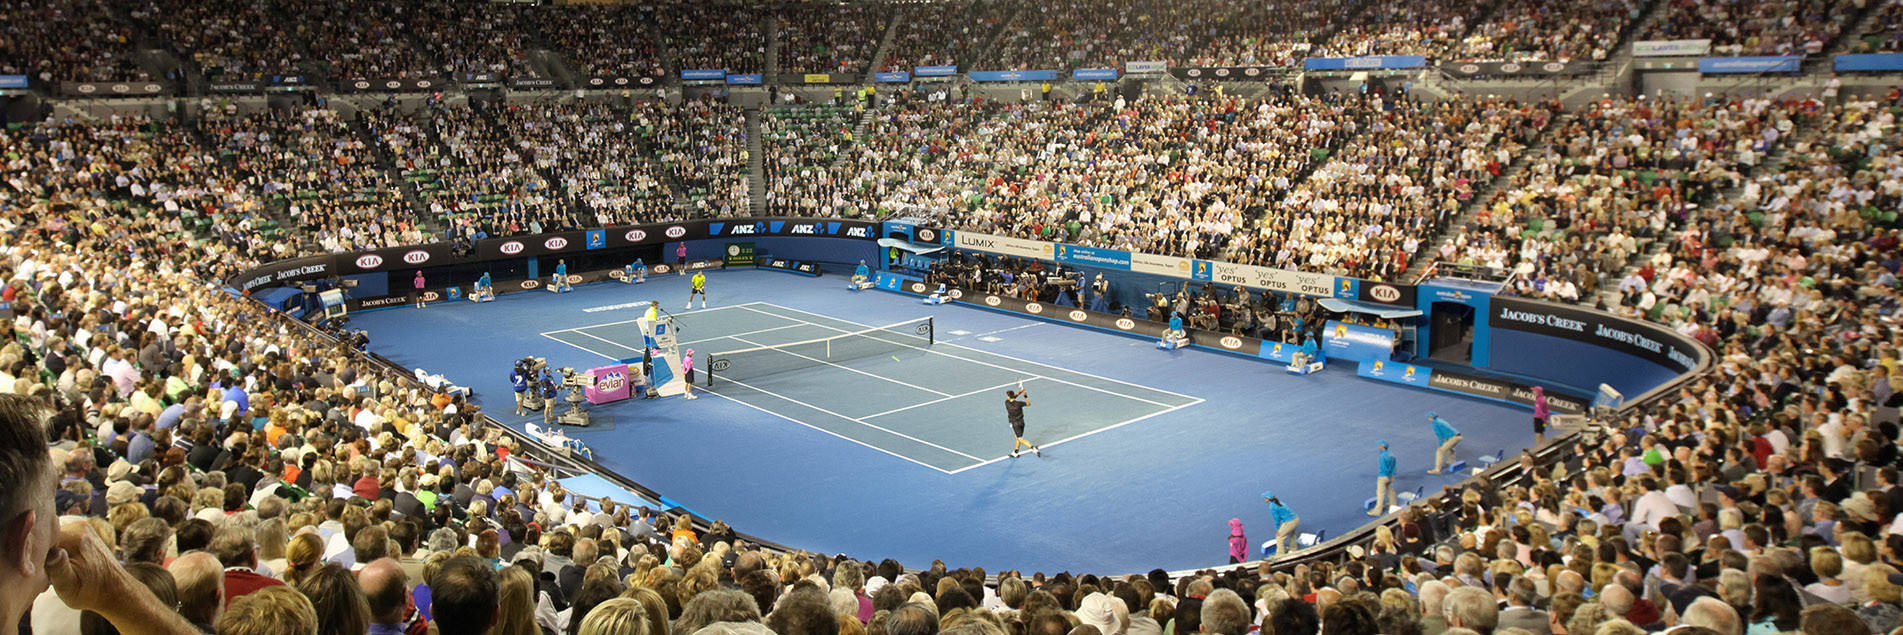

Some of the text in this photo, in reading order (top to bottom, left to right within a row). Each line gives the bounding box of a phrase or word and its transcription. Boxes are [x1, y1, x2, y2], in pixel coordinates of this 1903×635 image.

[731, 224, 755, 234] ANZ
[791, 224, 814, 234] ANZ
[846, 226, 866, 238] ANZ
[961, 234, 995, 248] LUMIX
[277, 264, 327, 280] JACOB'S CREEK
[1221, 274, 1246, 284] OPTUS
[1260, 279, 1287, 289] OPTUS
[1301, 284, 1329, 295] OPTUS
[1375, 287, 1396, 299] KIA
[361, 296, 407, 307] JACOB'S CREEK
[1500, 307, 1585, 332] JACOB'S CREEK
[1595, 323, 1663, 353] JACOB'S CREEK
[599, 378, 625, 391] evian
[1434, 374, 1500, 393] JACOB'S CREEK
[1513, 388, 1577, 411] JACO CREEK
